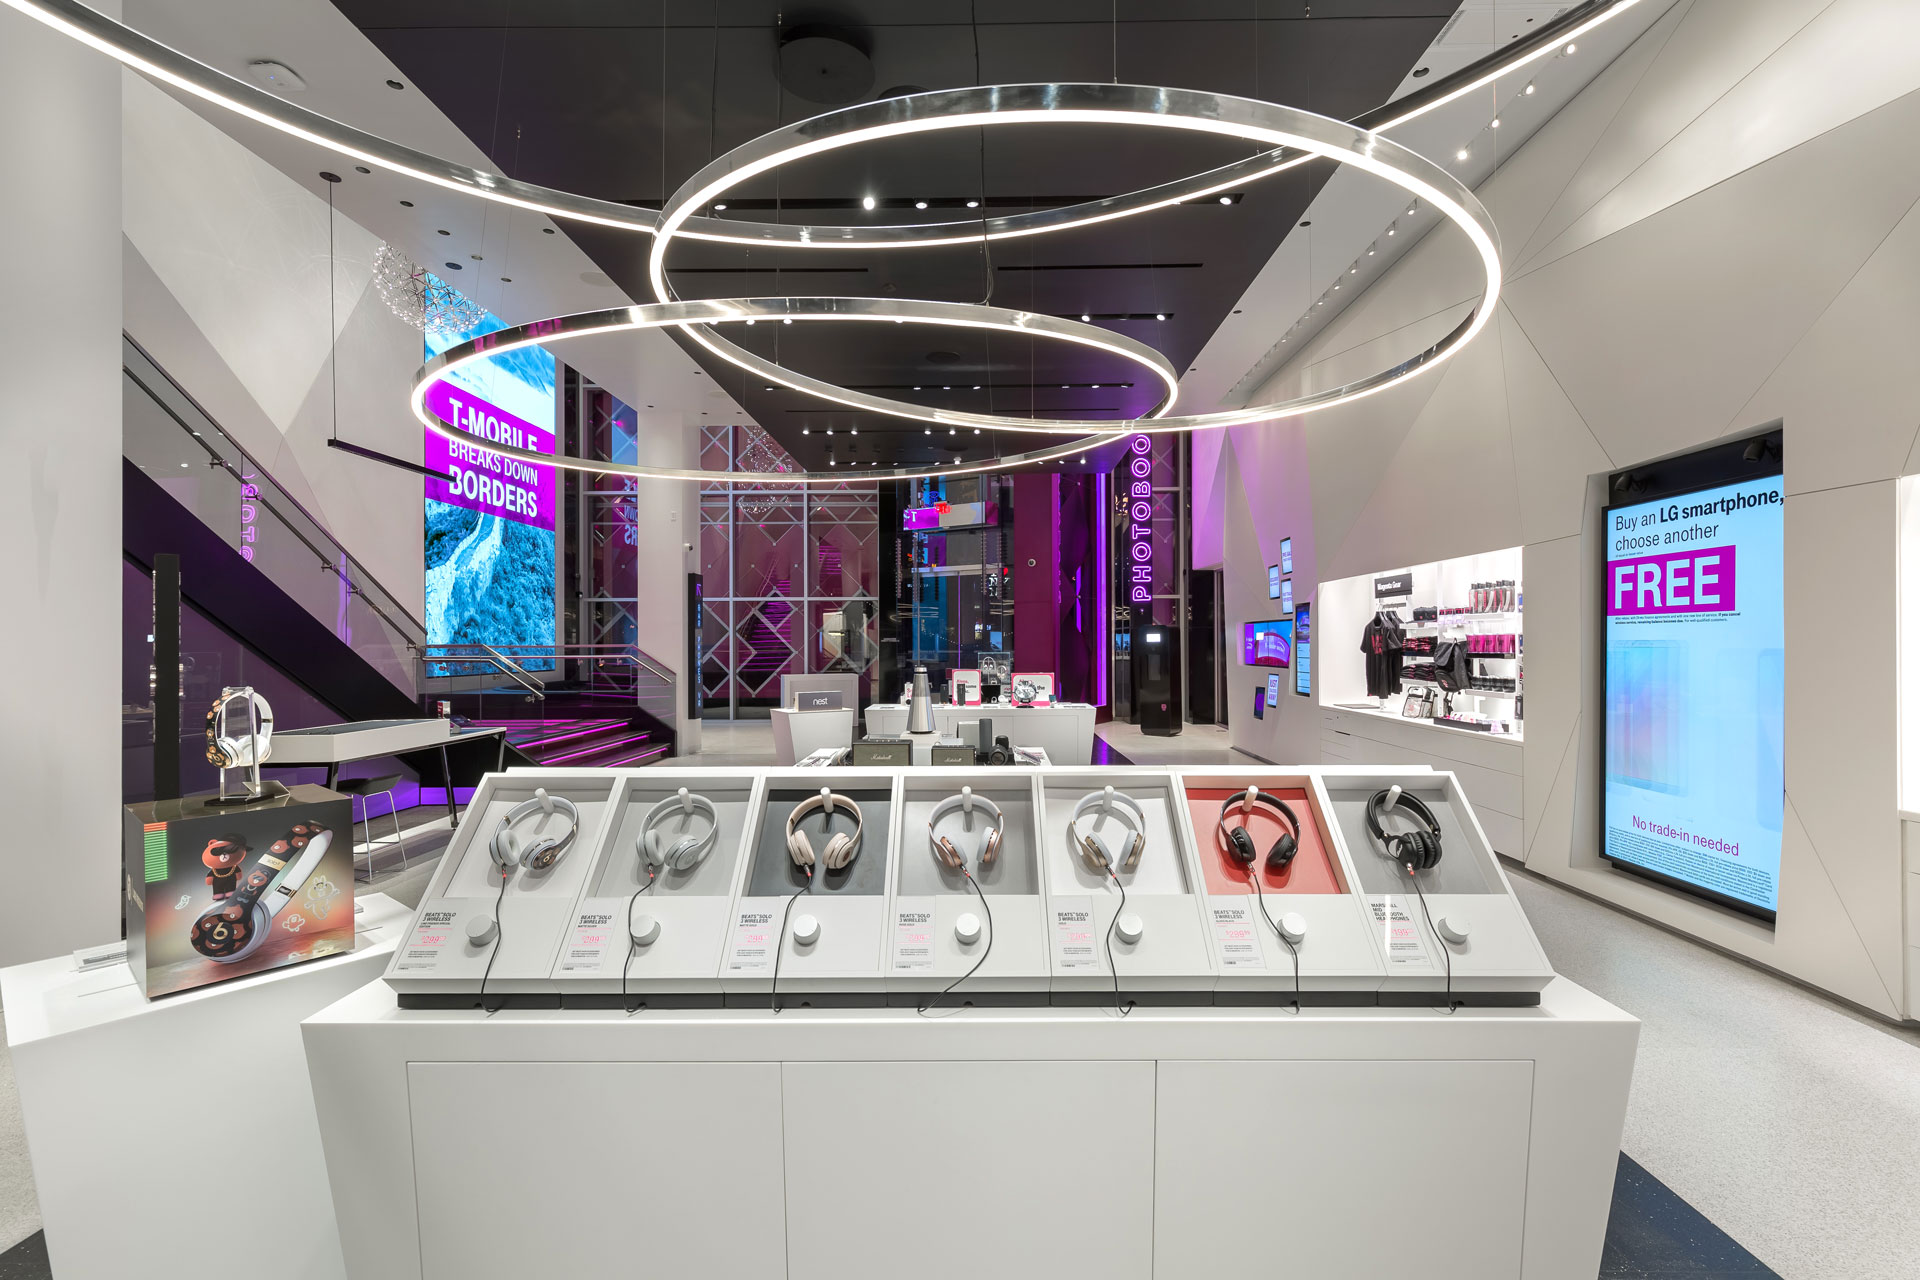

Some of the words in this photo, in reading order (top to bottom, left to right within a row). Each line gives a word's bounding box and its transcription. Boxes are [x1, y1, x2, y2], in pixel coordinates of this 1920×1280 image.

[449, 439, 501, 473] BREAKS
[504, 458, 538, 487] DOWN
[449, 464, 538, 518] BORDERS
[1616, 515, 1638, 531] Buy
[1641, 513, 1656, 527] an
[1660, 505, 1679, 523] LG
[1682, 490, 1784, 517] smartphone,
[1615, 535, 1660, 552] choose
[1664, 524, 1719, 545] another
[1615, 555, 1720, 609] FREE
[813, 698, 828, 706] nest
[1632, 815, 1647, 831] No
[1649, 821, 1690, 843] trade-in
[1693, 834, 1739, 857] needed
